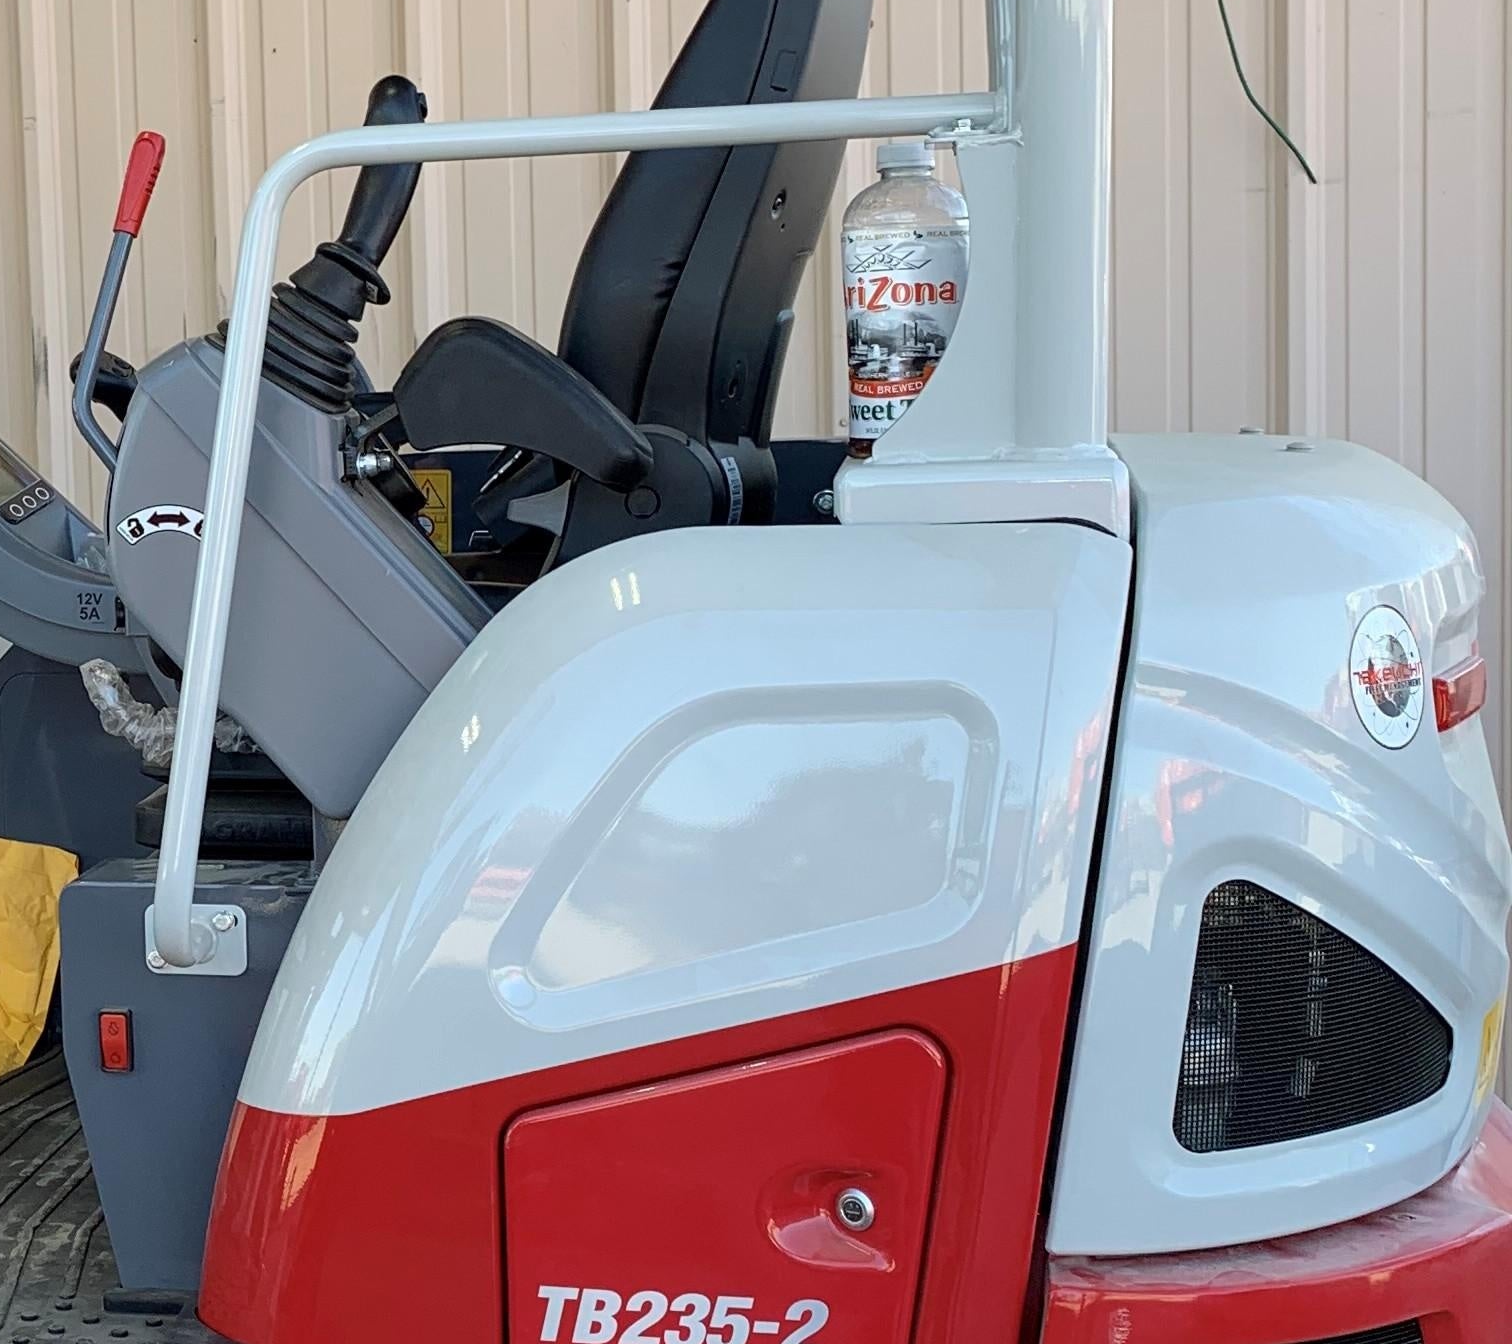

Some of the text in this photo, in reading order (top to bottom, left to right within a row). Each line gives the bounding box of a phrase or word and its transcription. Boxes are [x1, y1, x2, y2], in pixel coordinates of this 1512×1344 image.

[843, 277, 959, 312] riZona
[877, 381, 924, 395] BREWED
[850, 400, 897, 422] weet
[76, 592, 103, 606] 12V
[79, 606, 100, 621] 5A
